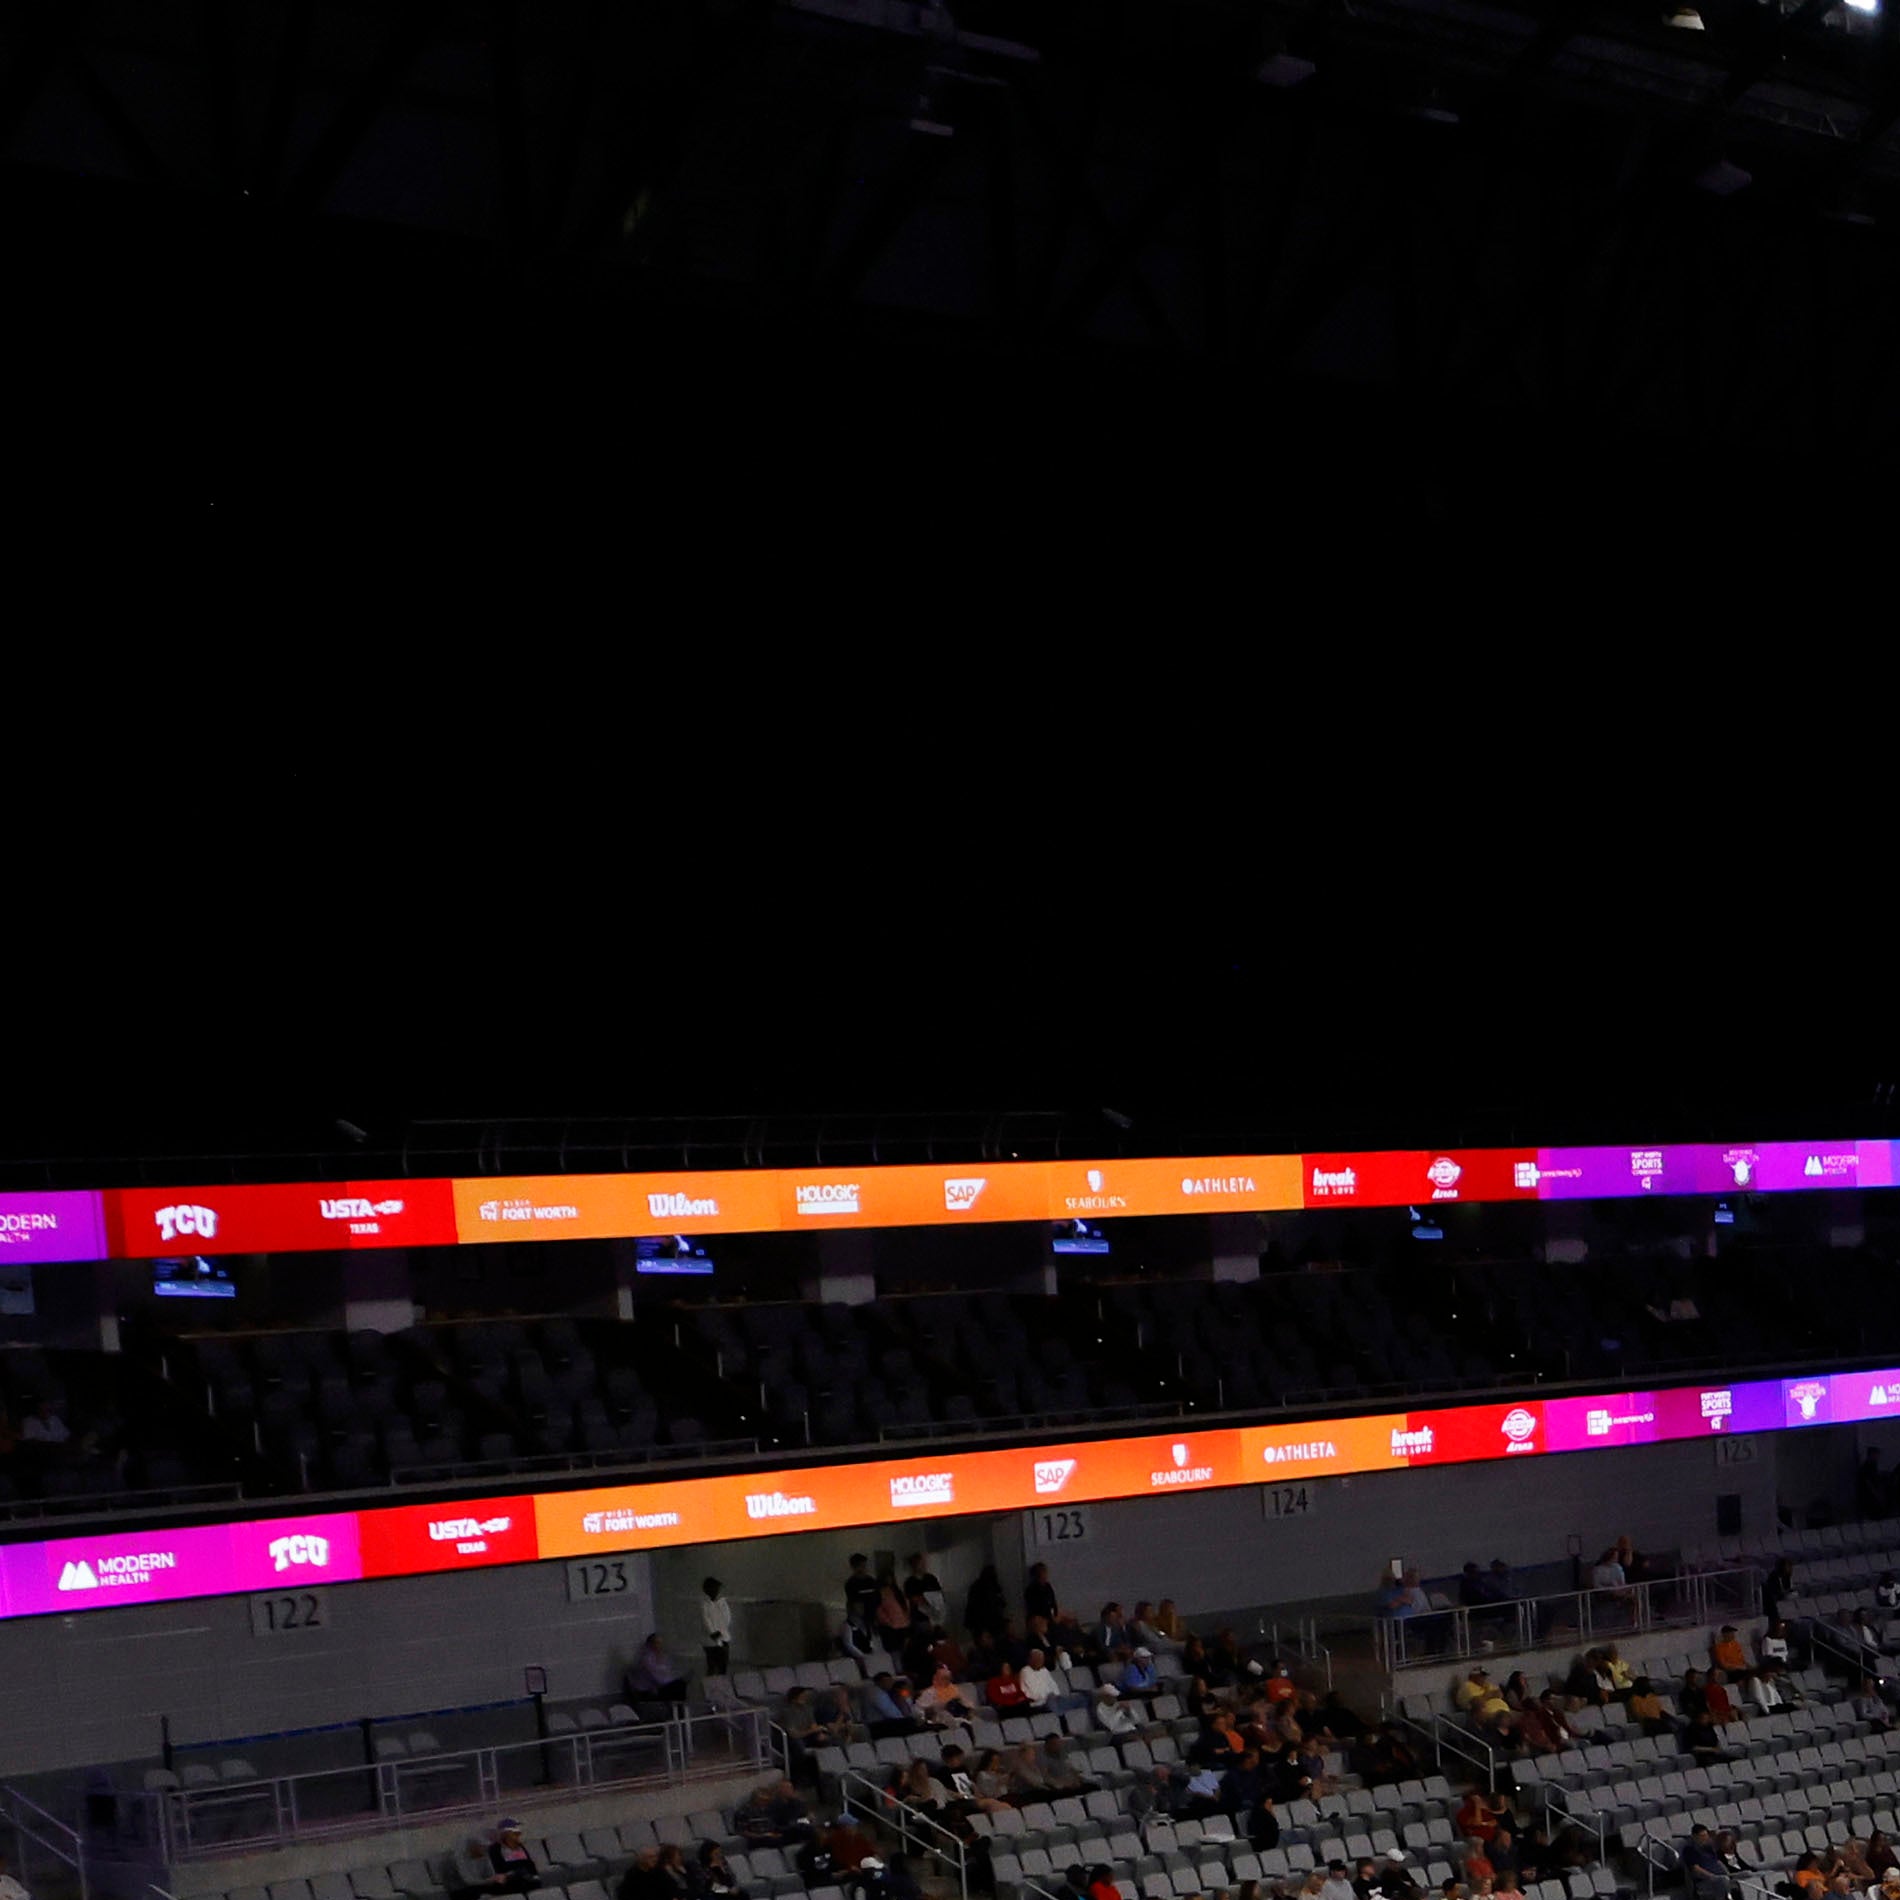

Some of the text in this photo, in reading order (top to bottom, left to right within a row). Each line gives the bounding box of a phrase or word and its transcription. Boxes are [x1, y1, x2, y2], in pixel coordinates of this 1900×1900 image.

[1193, 1178, 1255, 1194] ATHLETA
[1313, 1167, 1356, 1186] break
[796, 1184, 858, 1202] HOLOGIC
[947, 1186, 975, 1203] SAP
[320, 1199, 374, 1218] USTA
[503, 1205, 577, 1220] FORT WORTH
[648, 1193, 718, 1217] Wilson
[0, 1213, 57, 1231] ODERN
[155, 1205, 218, 1241] TCU
[1275, 1442, 1335, 1461] ATHLETA
[891, 1473, 952, 1494] HOLOGIC
[1037, 1467, 1064, 1486] SAP
[1151, 1467, 1212, 1486] SEABOURN
[746, 1493, 813, 1519] Wilson
[1272, 1490, 1308, 1515] 124
[429, 1519, 481, 1540] USTA
[605, 1512, 677, 1531] FORT WORTH
[1044, 1511, 1084, 1541] 123
[269, 1535, 328, 1572] TCU
[456, 1541, 486, 1554] TEXAS
[98, 1552, 175, 1574] MODERN
[99, 1571, 149, 1586] HEALTH
[581, 1563, 627, 1594] 123
[266, 1594, 320, 1630] 122
